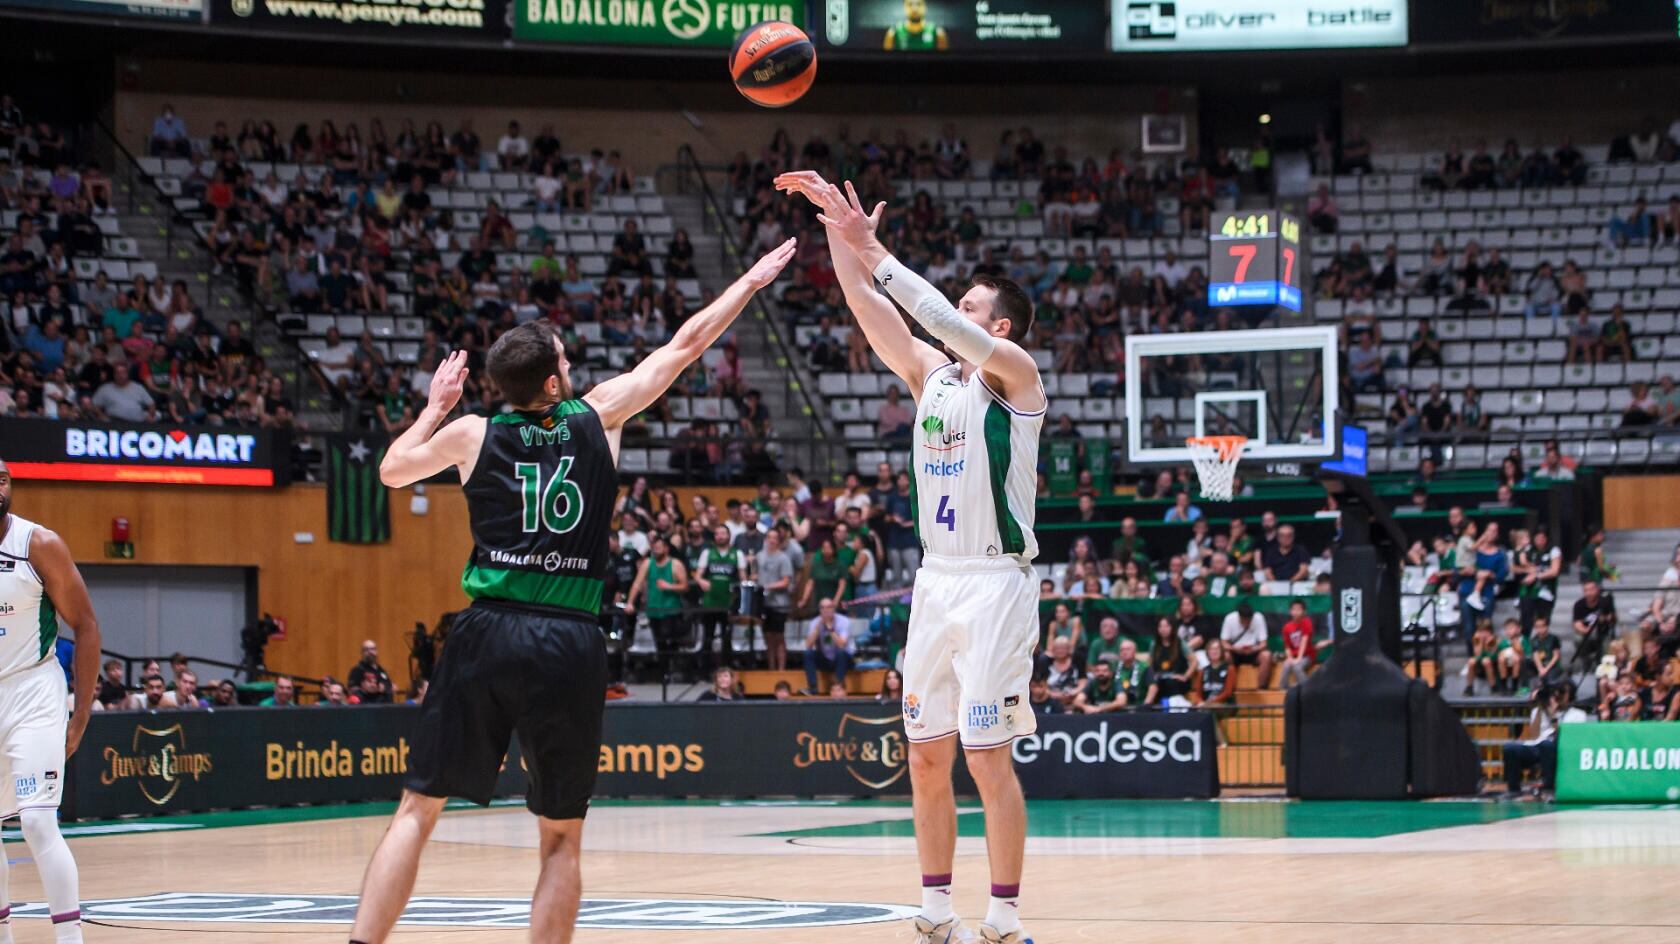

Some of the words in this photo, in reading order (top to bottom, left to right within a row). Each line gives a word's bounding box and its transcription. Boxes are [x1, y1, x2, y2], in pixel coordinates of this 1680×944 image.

[266, 0, 484, 27] www.penya.com
[527, 0, 656, 27] BADALONA
[716, 0, 793, 31] FUTUR
[1186, 12, 1276, 29] oliver
[1221, 214, 1269, 238] 4:41
[1228, 244, 1257, 284] 7
[66, 428, 256, 462] BRICOMART
[515, 456, 584, 534] 16
[936, 495, 955, 532] 4
[266, 740, 353, 780] Brinda
[597, 743, 705, 779] amps
[793, 731, 858, 768] Juvé
[860, 741, 888, 762] &
[1012, 721, 1201, 763] endesa
